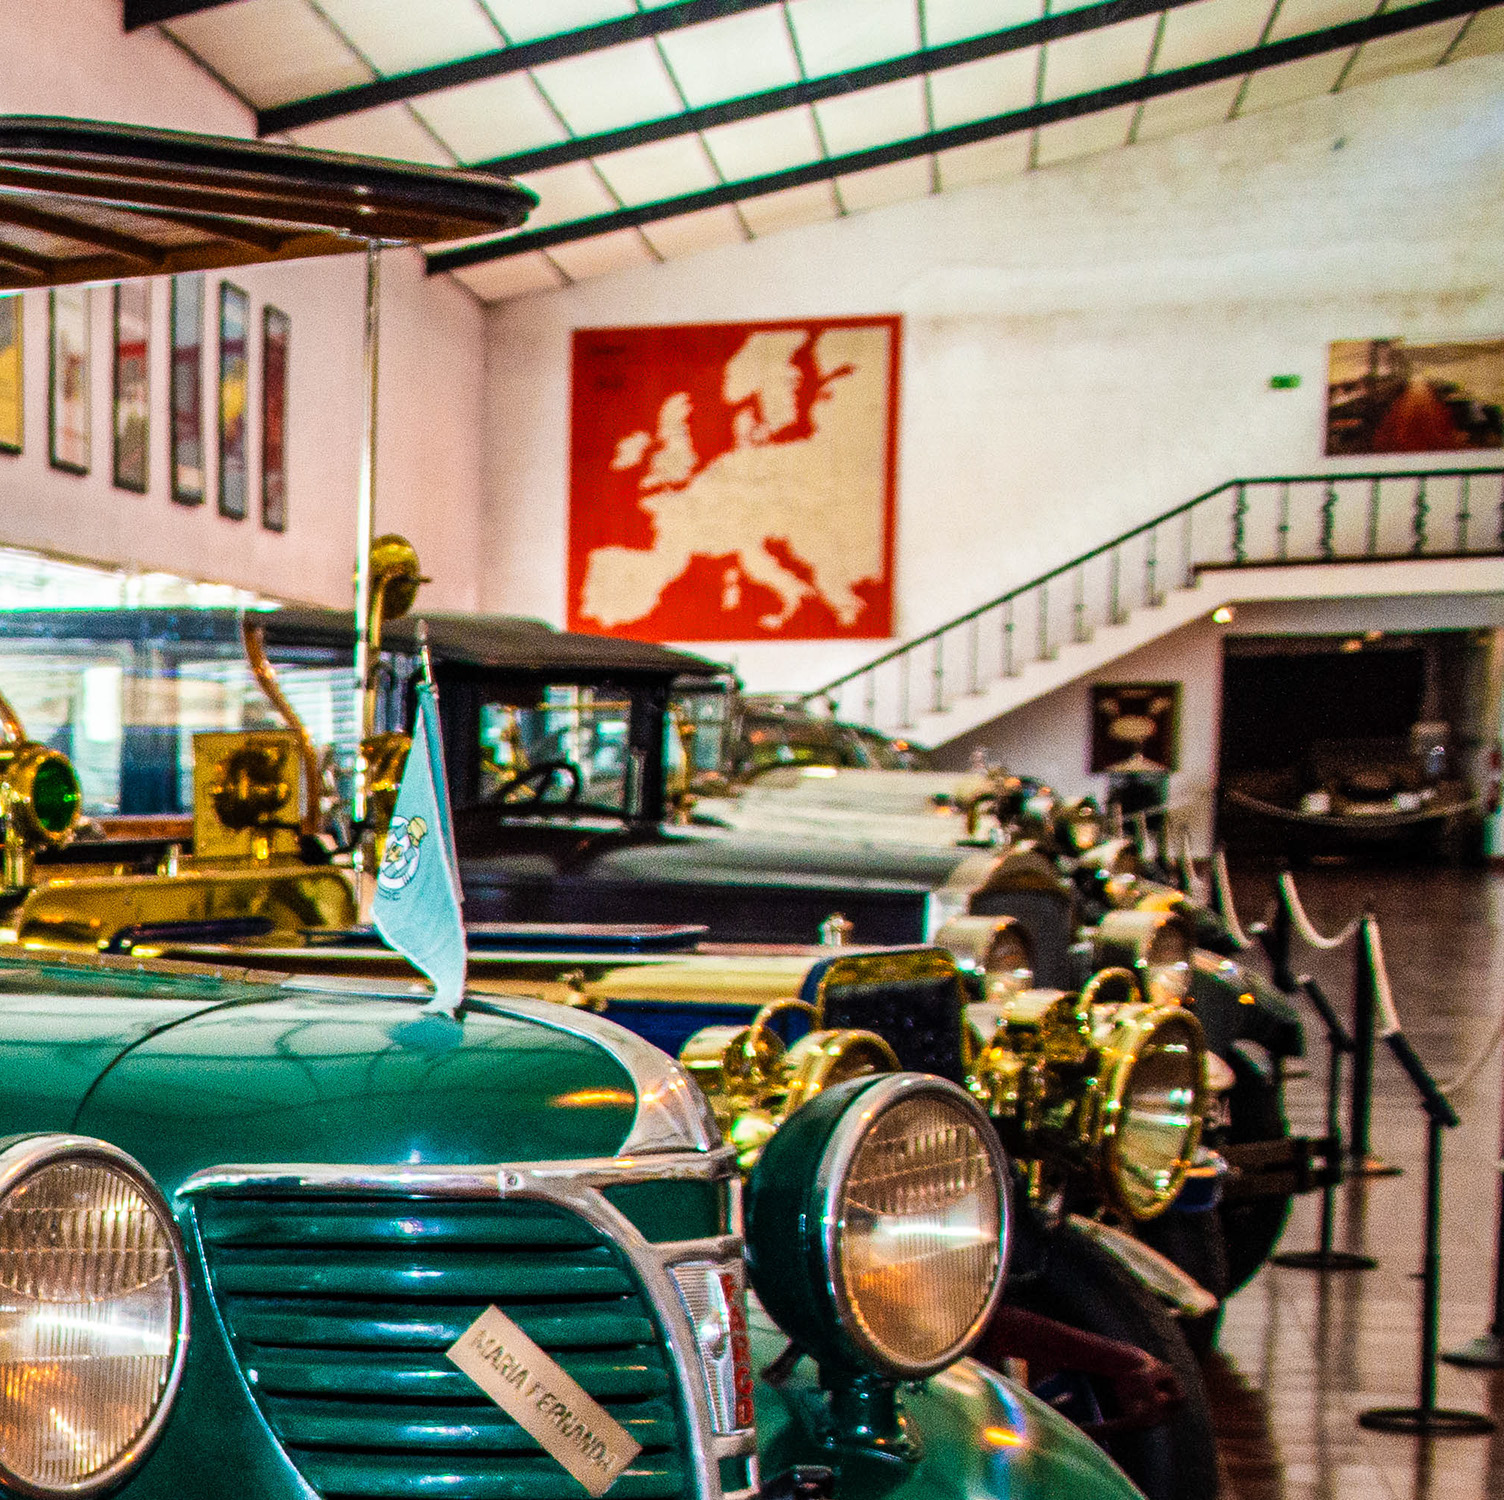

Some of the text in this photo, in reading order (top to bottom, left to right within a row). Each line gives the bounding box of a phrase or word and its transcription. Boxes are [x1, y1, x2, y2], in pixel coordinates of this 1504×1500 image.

[470, 1329, 619, 1472] MARIA FERNANDA
[721, 1273, 755, 1426] FARGO
